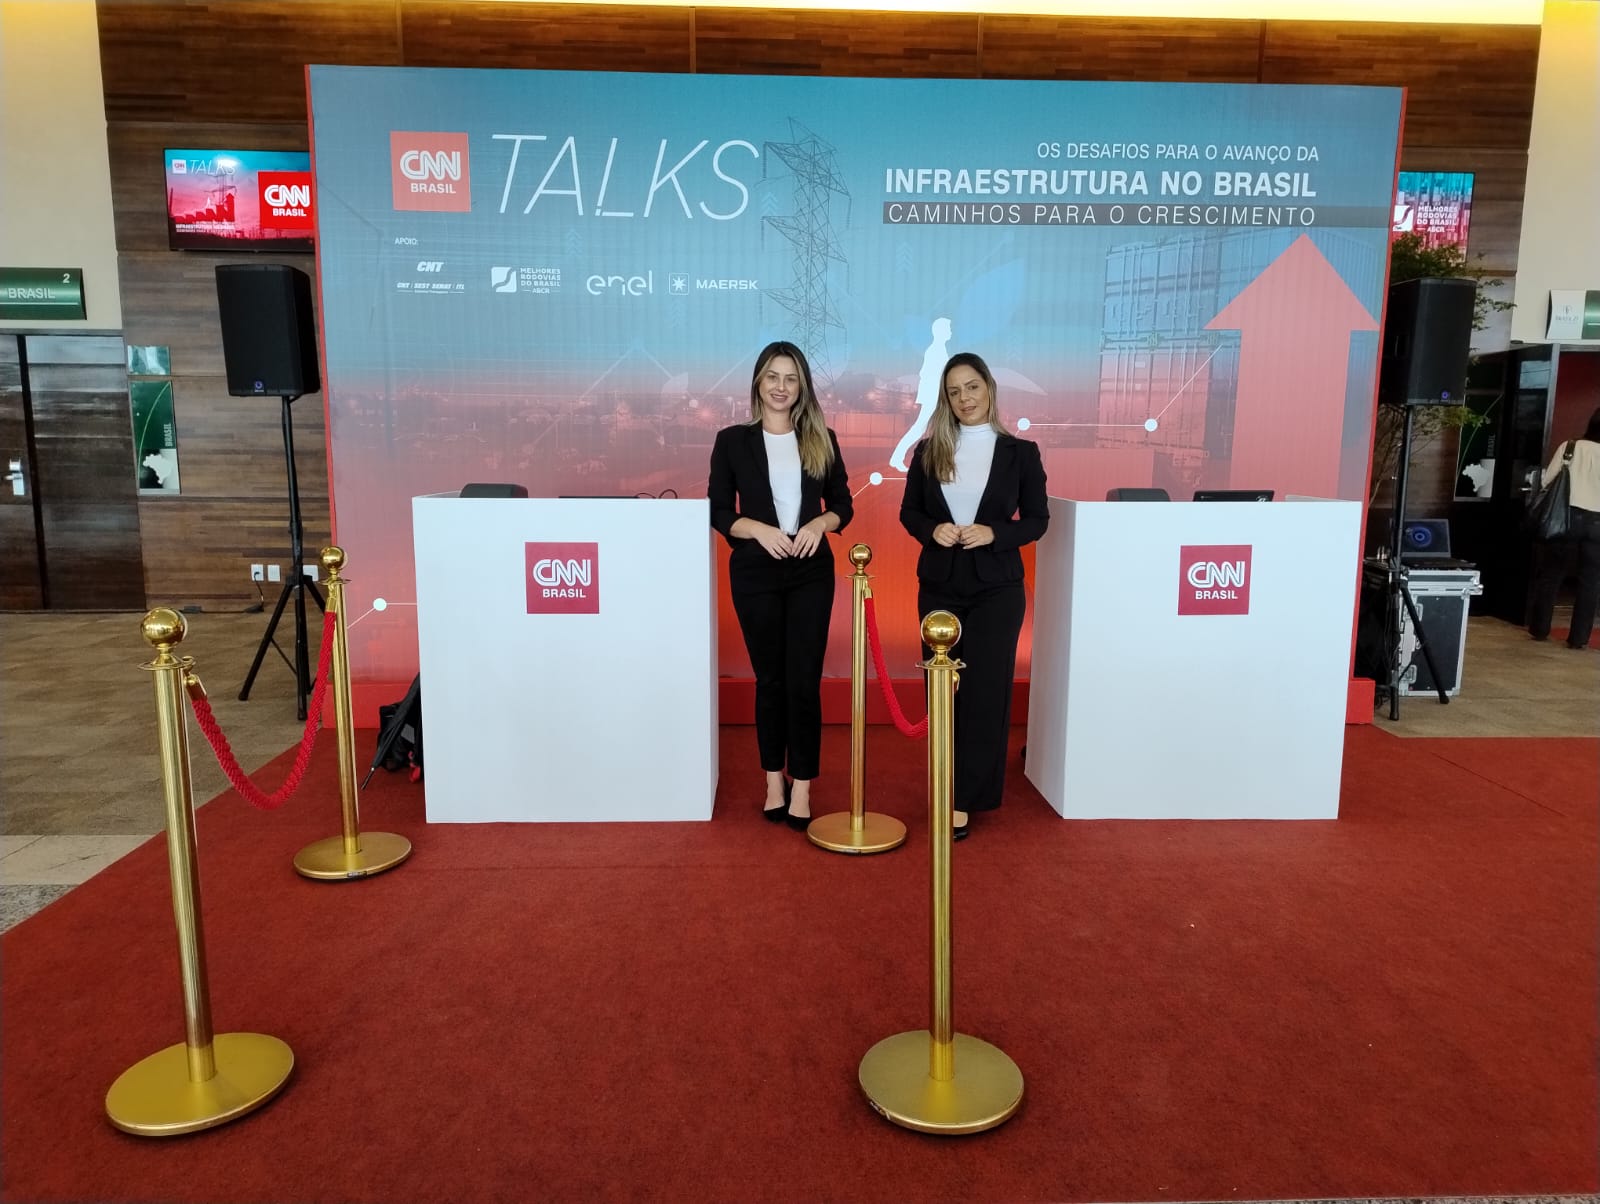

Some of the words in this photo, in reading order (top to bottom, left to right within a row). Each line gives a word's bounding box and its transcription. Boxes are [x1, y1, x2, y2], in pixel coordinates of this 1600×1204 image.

[1037, 142, 1061, 159] OS
[1067, 142, 1150, 160] DESAFIOS
[1155, 144, 1199, 160] PARA
[1205, 145, 1217, 161] O
[1223, 145, 1291, 165] AVANÇO
[1297, 146, 1319, 162] DA
[400, 150, 461, 181] CNN
[492, 134, 760, 220] TALKS
[885, 168, 1149, 195] INFRAESTRUTURA
[1160, 171, 1202, 196] NO
[1214, 171, 1317, 197] BRASIL
[410, 182, 457, 194] BRASIL
[264, 185, 310, 208] CNN
[272, 207, 307, 217] BRASIL
[888, 203, 1021, 225] CAMINHOS
[1034, 205, 1097, 224] PARA
[1109, 205, 1125, 225] O
[1138, 205, 1316, 226] CRESCIMENTO
[1418, 205, 1458, 213] MELHORES
[394, 237, 419, 246] APOIO:
[416, 261, 444, 272] CNT
[520, 267, 561, 275] MELHORES
[63, 273, 71, 284] 2
[520, 273, 561, 281] RODOVIAS
[586, 269, 653, 296] enel
[696, 279, 758, 290] MAERSK
[8, 287, 56, 299] BRASIL
[163, 422, 173, 447] BRASIL
[533, 559, 592, 587] CNN
[1187, 561, 1246, 588] CNN
[542, 588, 587, 598] BRASIL
[1194, 590, 1239, 600] BRASIL
